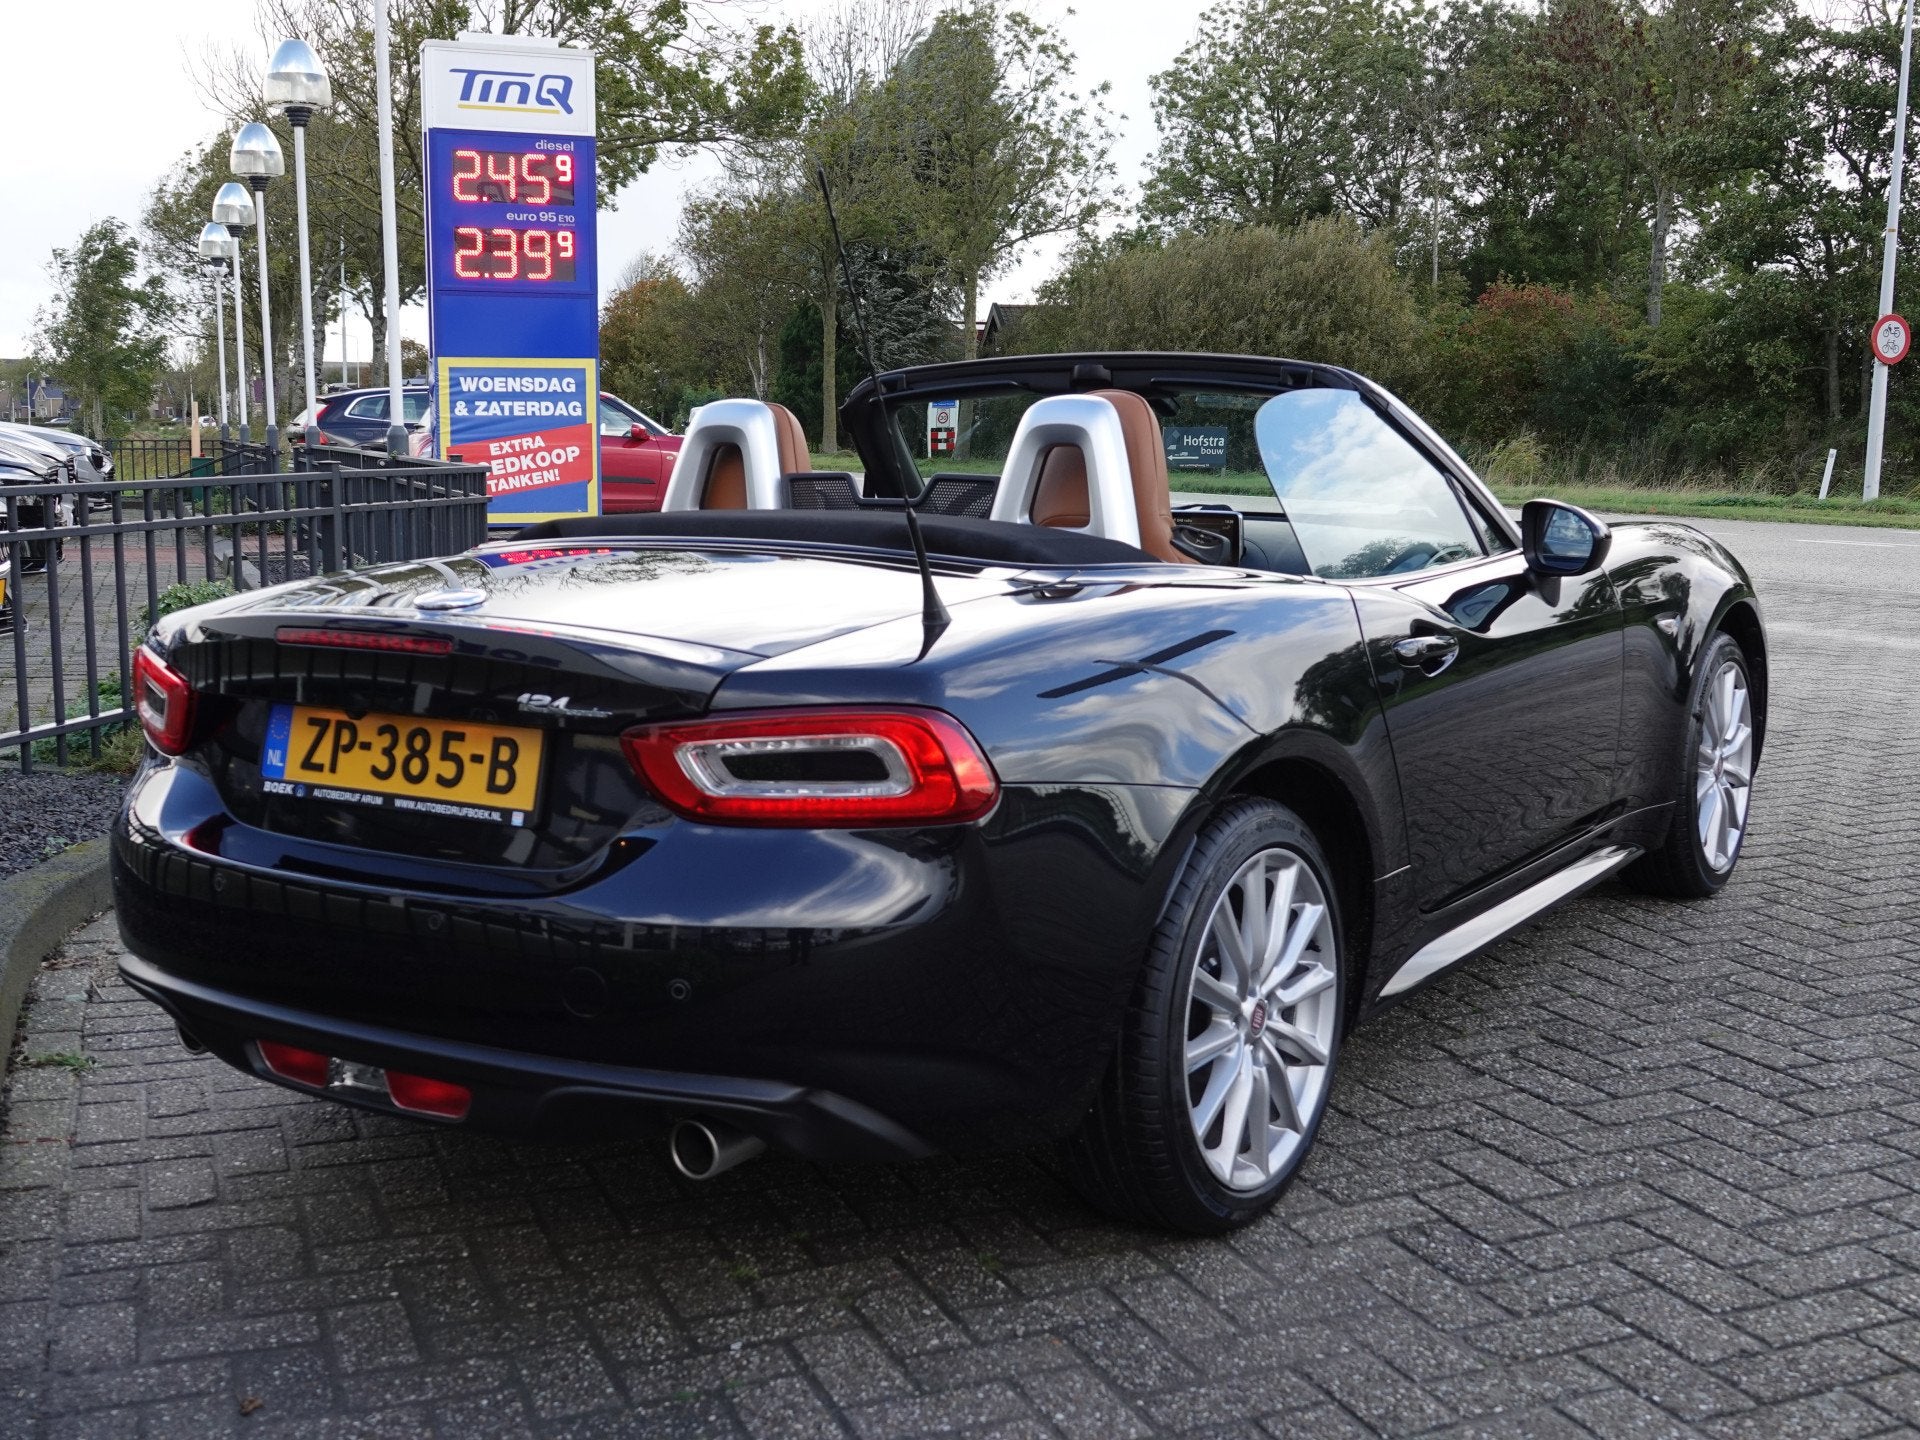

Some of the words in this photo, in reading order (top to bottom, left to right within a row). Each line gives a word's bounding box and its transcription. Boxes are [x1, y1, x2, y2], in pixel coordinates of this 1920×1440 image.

[535, 140, 575, 152] diesel
[506, 212, 537, 222] euro
[539, 211, 557, 223] 95
[558, 214, 575, 223] E10
[459, 376, 576, 393] WOENSDAG
[454, 401, 468, 416] &
[475, 401, 582, 417] ZATERDAG
[489, 435, 545, 456] EXTRA
[1183, 435, 1224, 447] Hofstra
[478, 446, 580, 477] EDKOOP
[486, 468, 560, 493] TANKEN!
[517, 692, 570, 709] 124
[267, 748, 284, 767] NL
[300, 715, 519, 795] ZP-385-B
[263, 780, 294, 795] BOEK
[312, 788, 361, 802] AUTOBEDRIJF
[361, 794, 384, 805] ARUM
